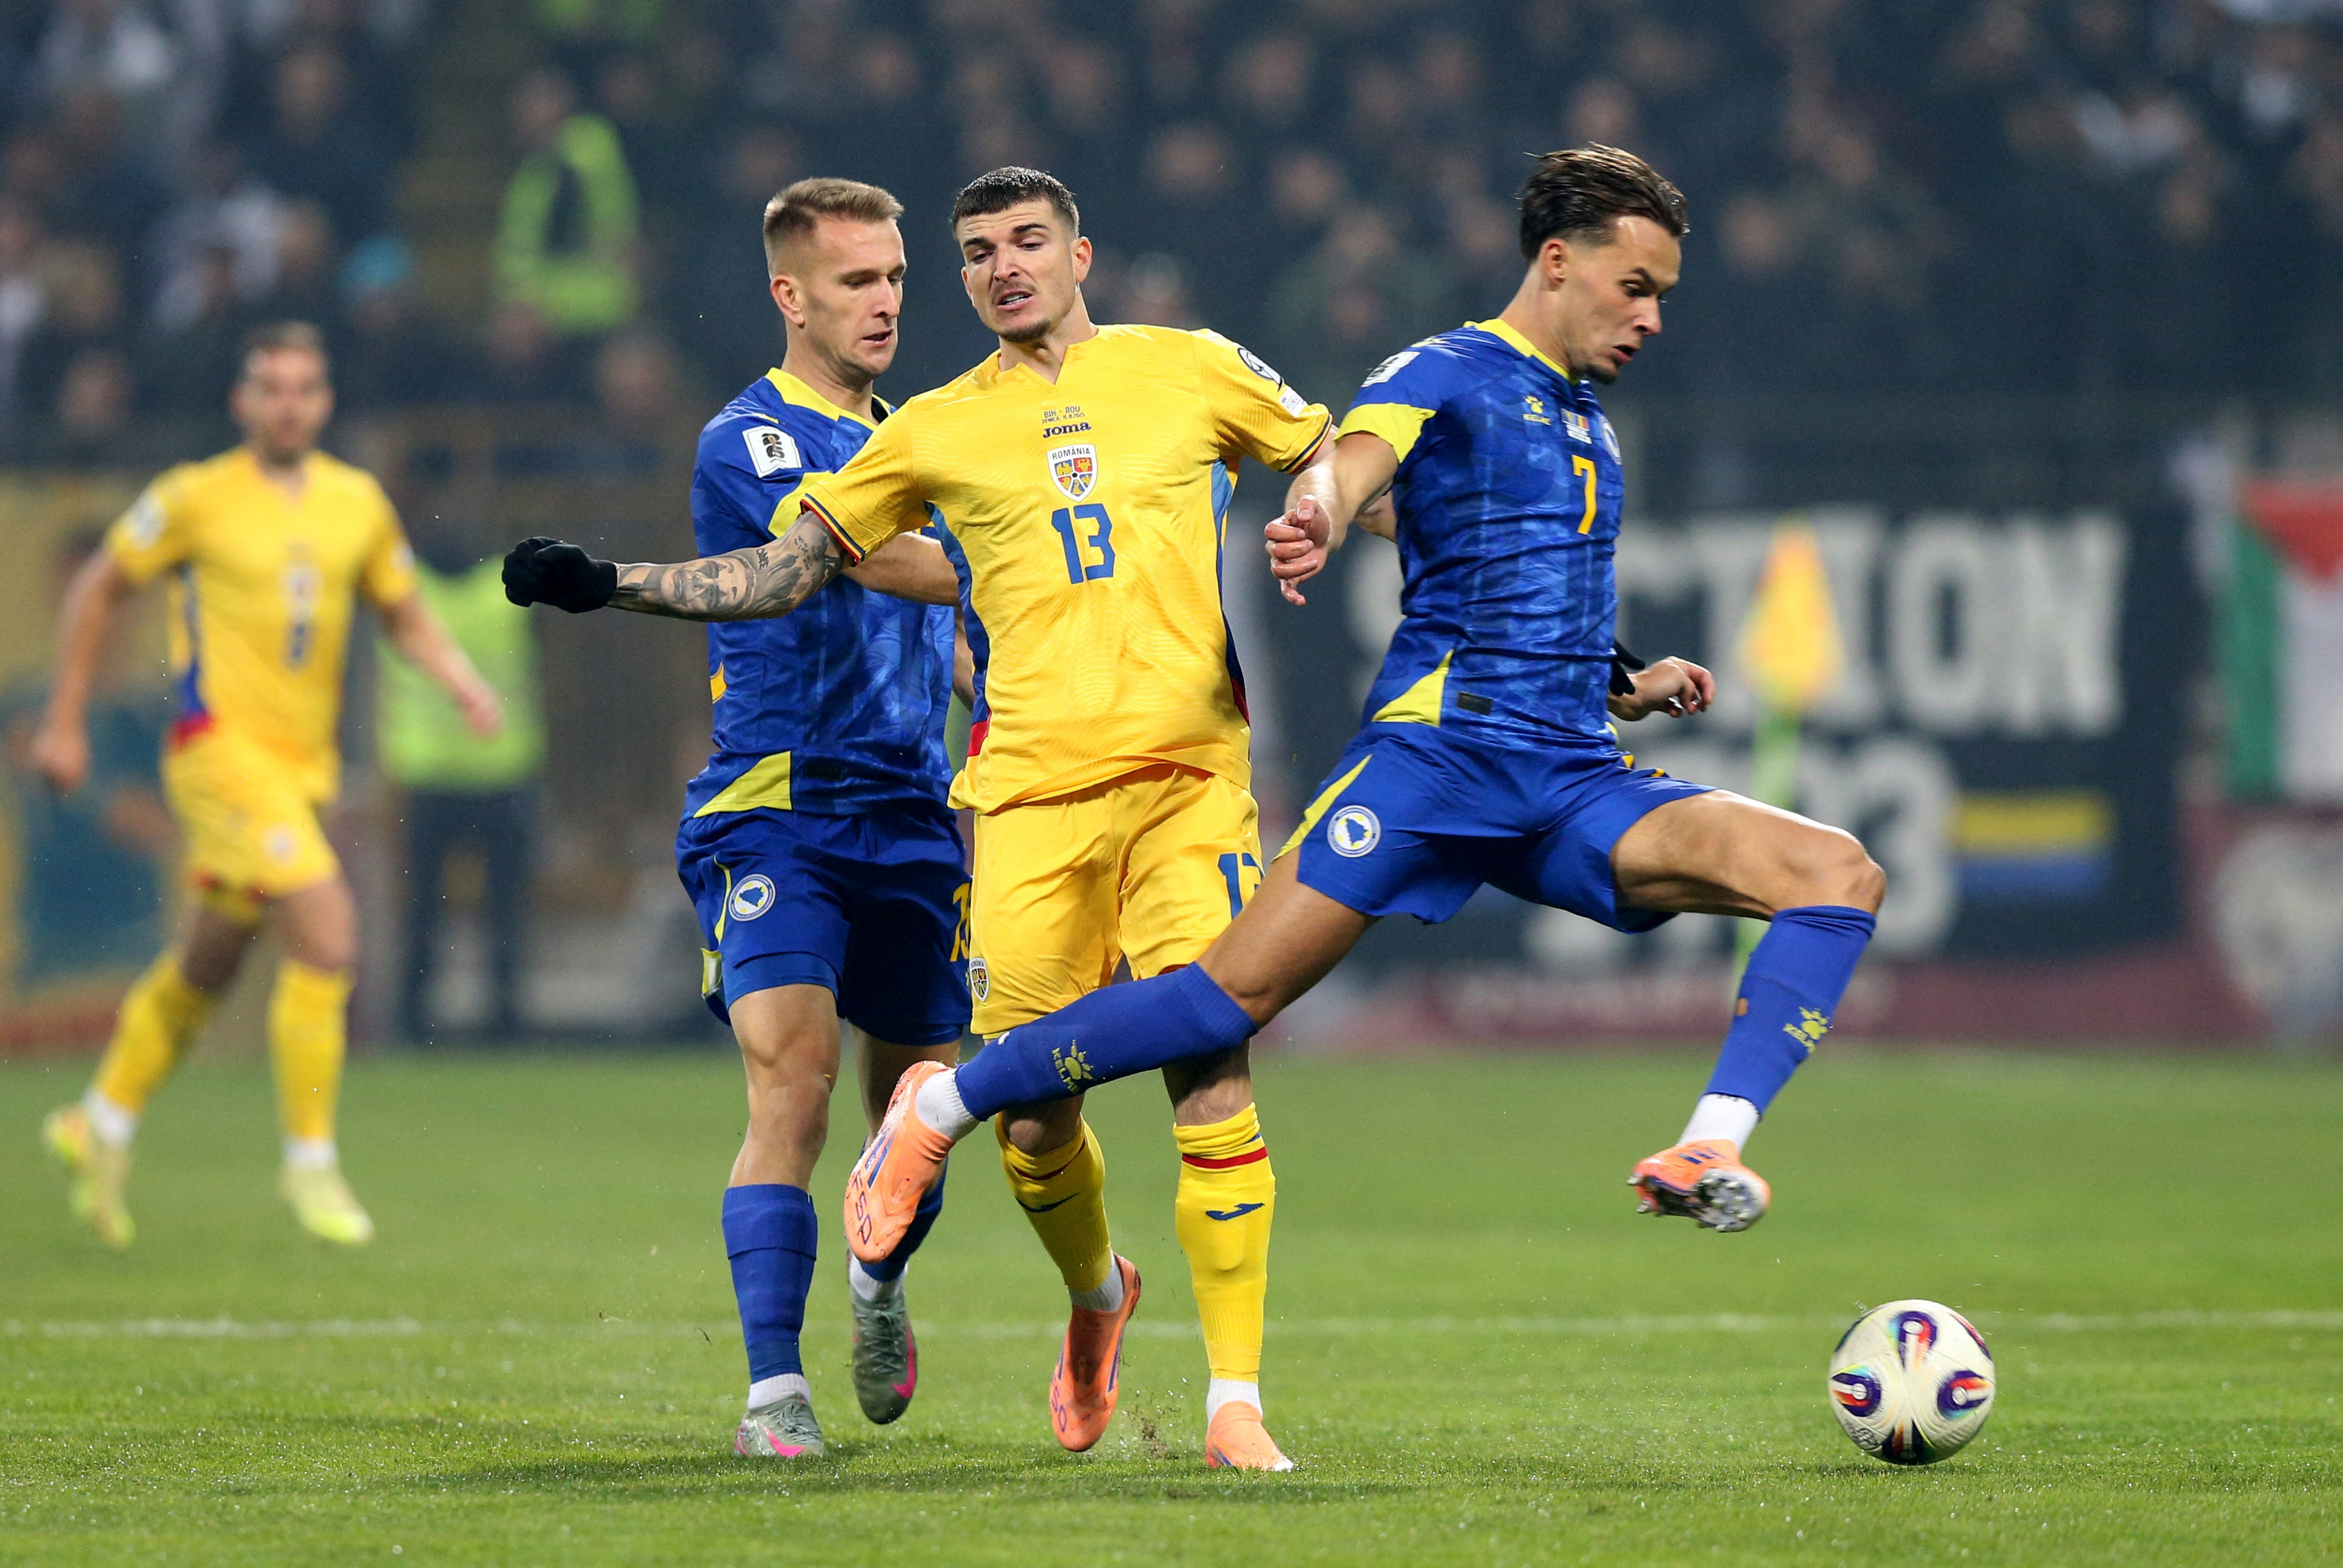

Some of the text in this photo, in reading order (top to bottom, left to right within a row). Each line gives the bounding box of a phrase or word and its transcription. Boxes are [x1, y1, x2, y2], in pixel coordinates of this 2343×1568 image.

[1044, 409, 1056, 418] BIH
[1065, 406, 1080, 414] ROU
[1571, 455, 1598, 535] 7
[1051, 503, 1115, 584] 13
[1345, 511, 2124, 741] STION
